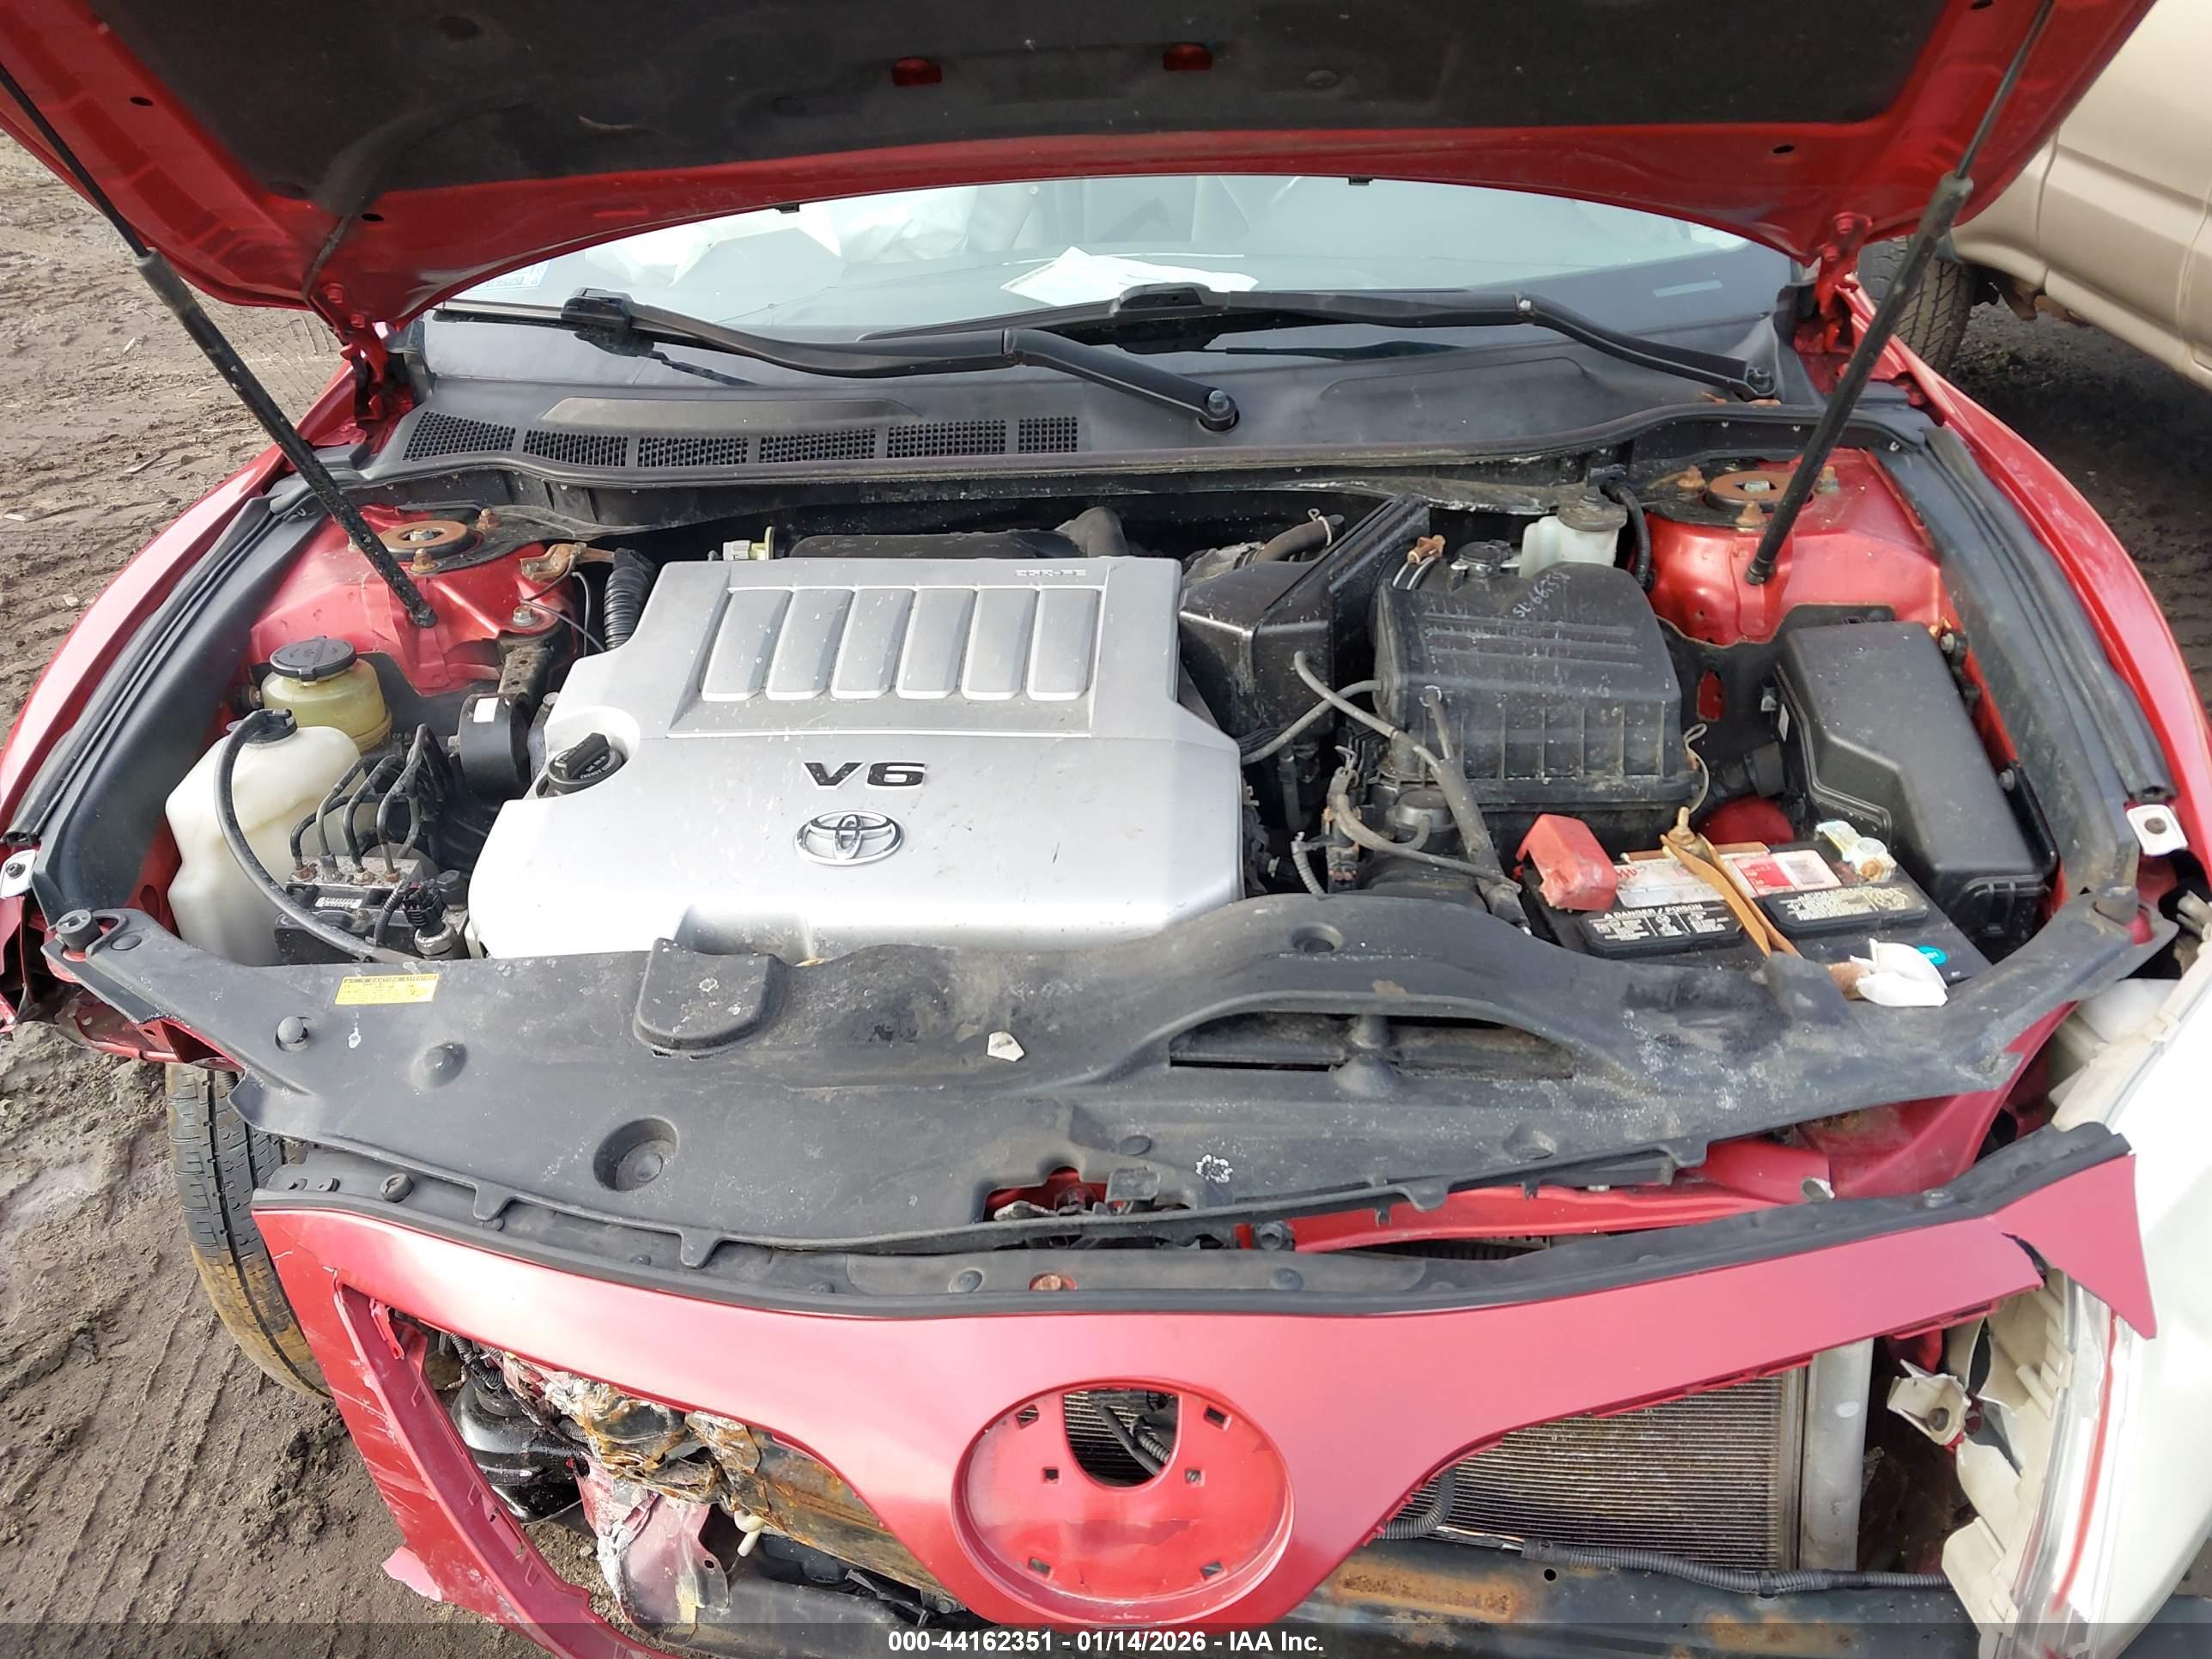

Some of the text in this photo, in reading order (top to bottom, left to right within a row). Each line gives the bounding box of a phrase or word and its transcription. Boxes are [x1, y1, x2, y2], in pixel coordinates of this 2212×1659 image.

[801, 761, 929, 791] V6
[1613, 908, 1656, 919] DANGER
[1665, 903, 1704, 914] POISON
